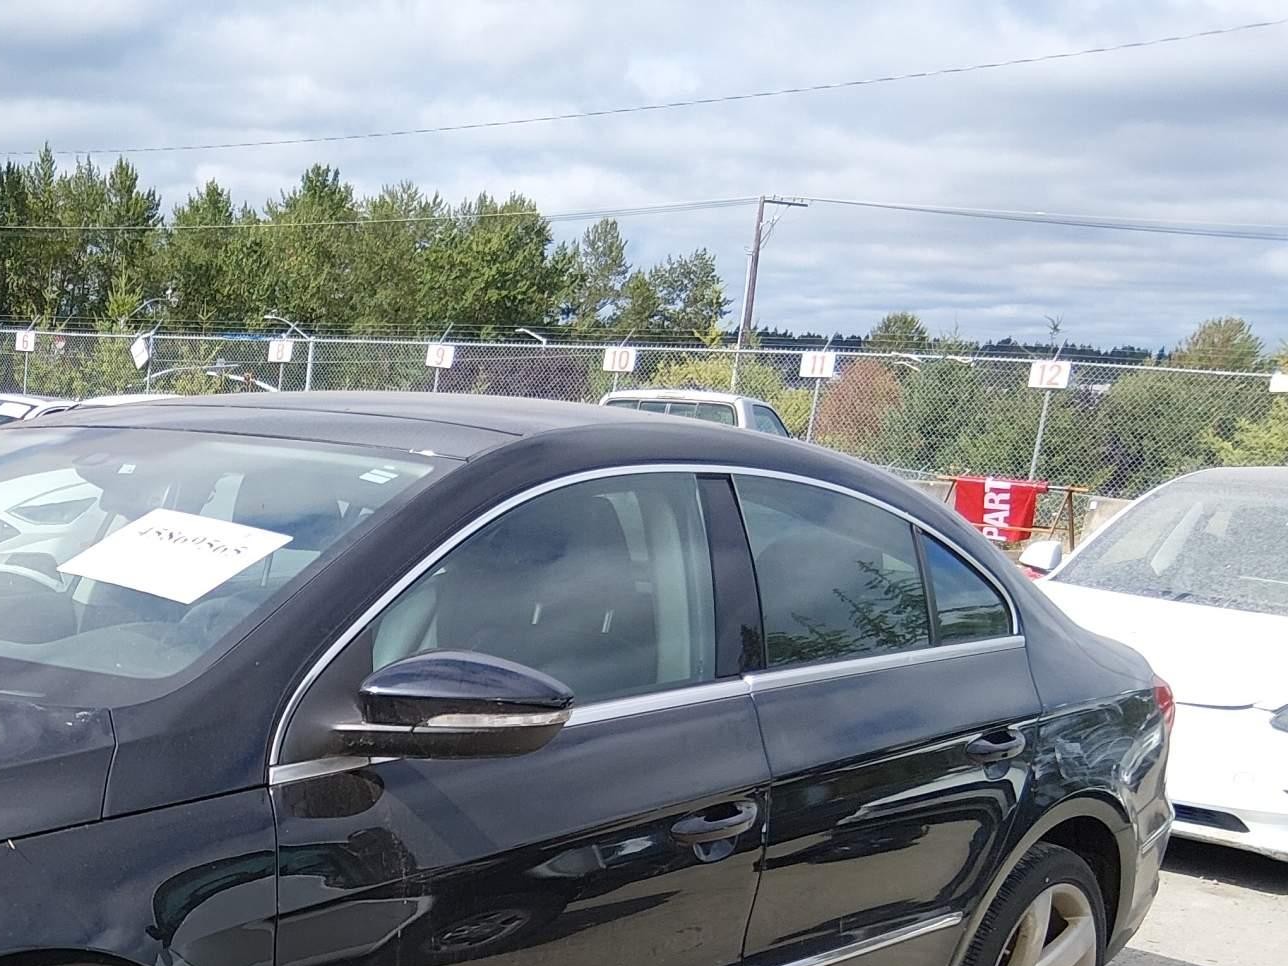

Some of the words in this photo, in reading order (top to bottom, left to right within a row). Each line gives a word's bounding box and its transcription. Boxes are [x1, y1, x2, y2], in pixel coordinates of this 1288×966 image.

[610, 350, 630, 370] 10
[810, 354, 826, 375] 11
[1038, 363, 1062, 386] 12
[982, 477, 1012, 541] PART
